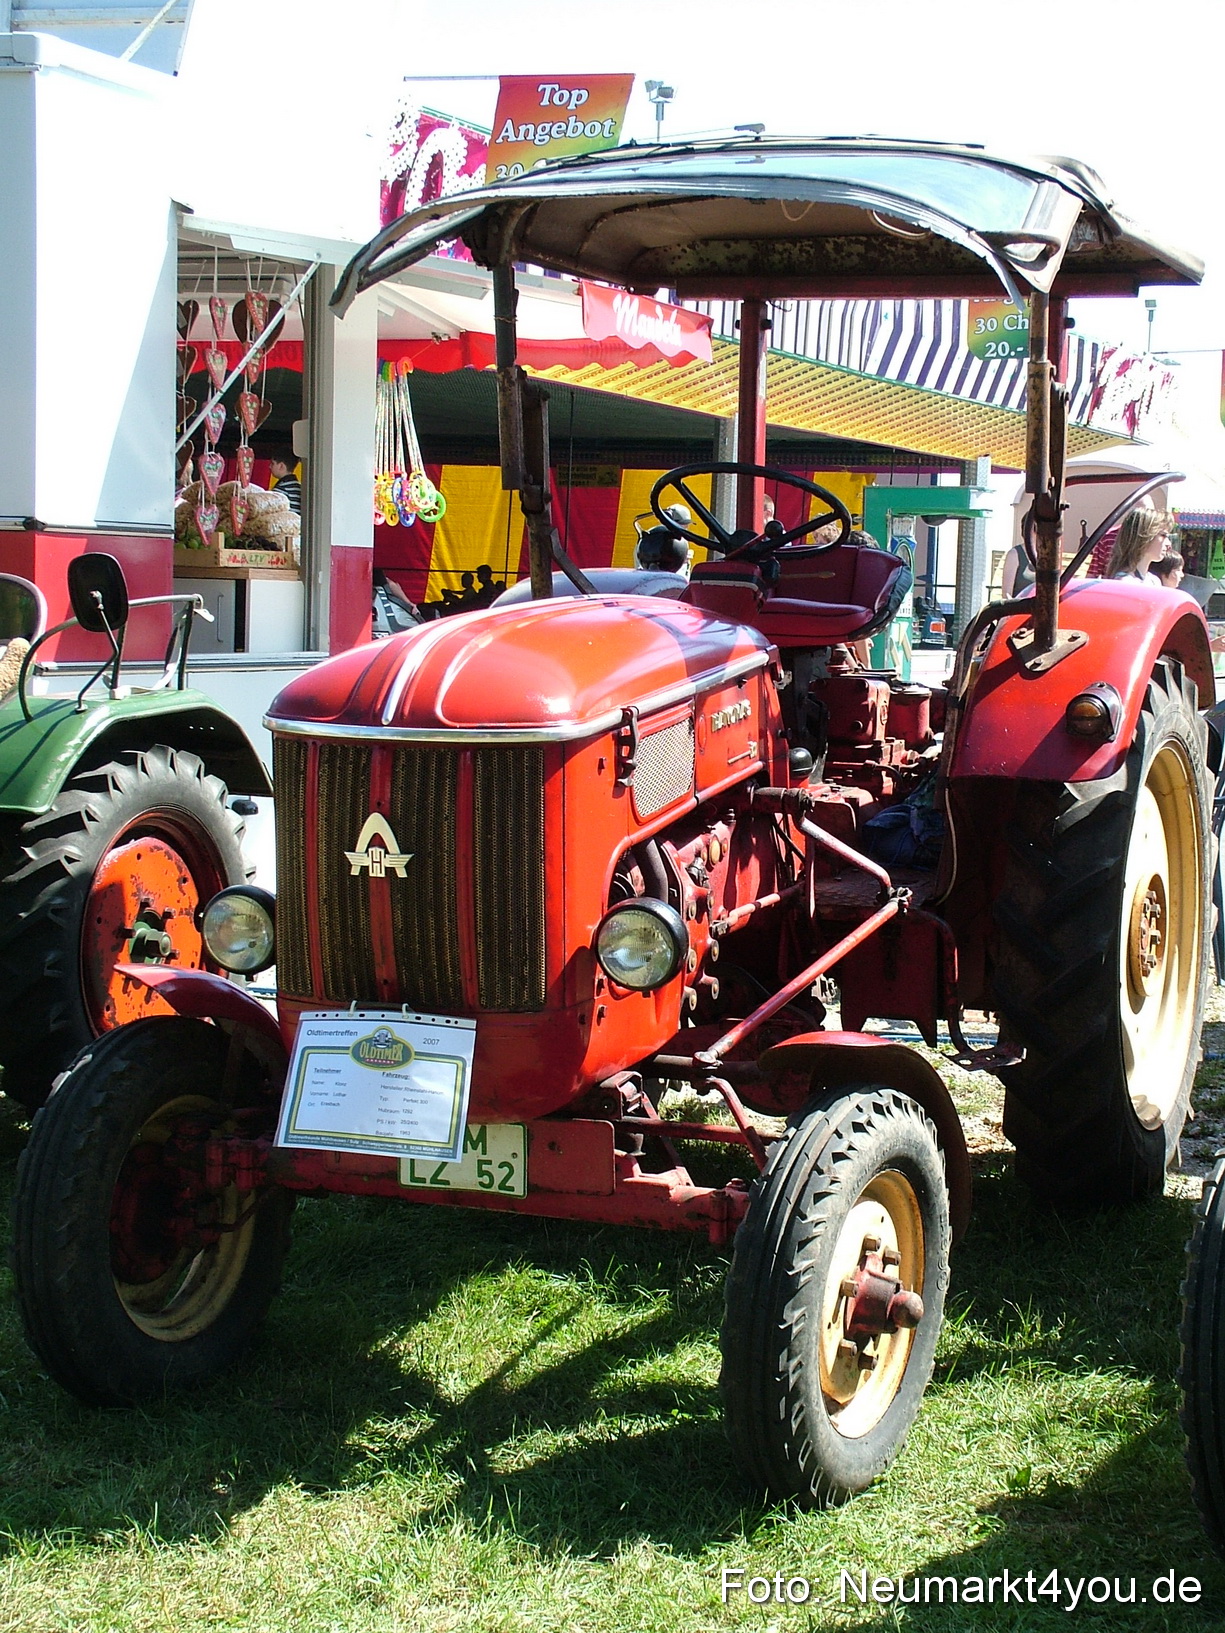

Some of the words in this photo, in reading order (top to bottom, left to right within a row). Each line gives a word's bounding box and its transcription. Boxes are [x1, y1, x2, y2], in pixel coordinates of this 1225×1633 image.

[537, 83, 590, 110] Top
[495, 115, 617, 146] Angebot
[974, 317, 998, 335] 30
[1003, 314, 1030, 331] Ch
[984, 341, 1024, 358] 20.-
[306, 1029, 358, 1037] Oldtimertreffen
[422, 1037, 440, 1046] 2007
[359, 1041, 403, 1062] OLDTIMER
[477, 1159, 515, 1192] 52
